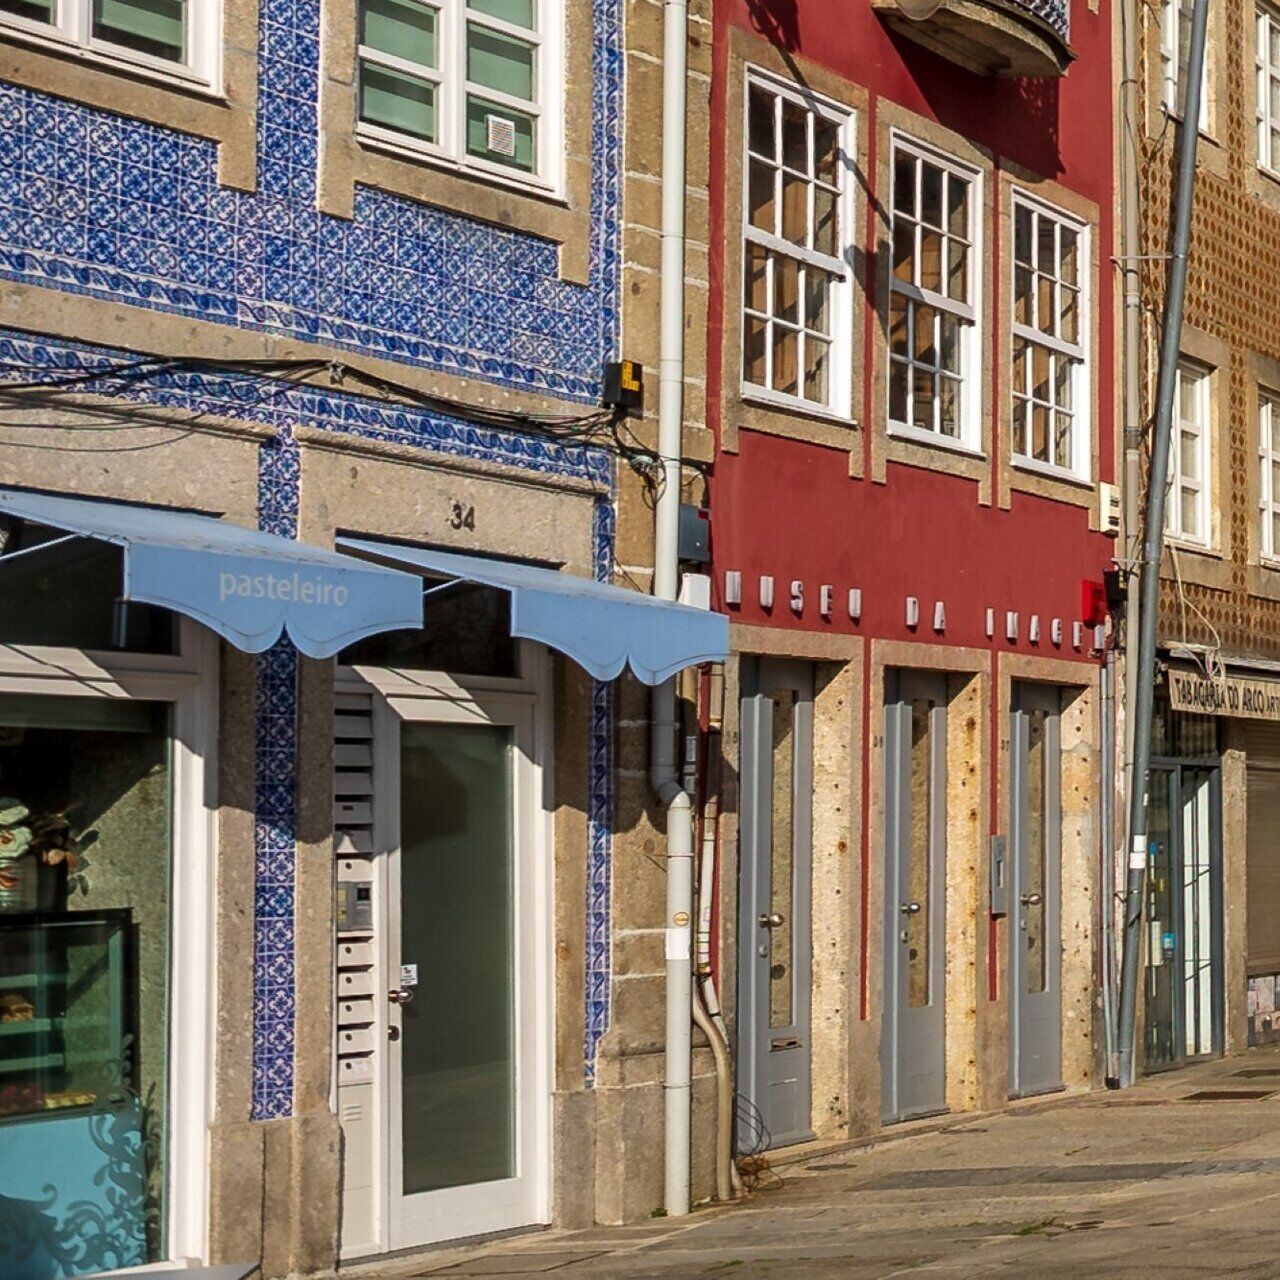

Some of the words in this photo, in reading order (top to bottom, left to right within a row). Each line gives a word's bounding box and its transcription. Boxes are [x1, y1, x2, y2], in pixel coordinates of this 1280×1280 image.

[450, 504, 476, 531] 34
[219, 573, 348, 607] pasteleiro
[725, 571, 862, 618] MUSEU
[906, 597, 946, 630] DA
[1242, 686, 1265, 714] ARCO
